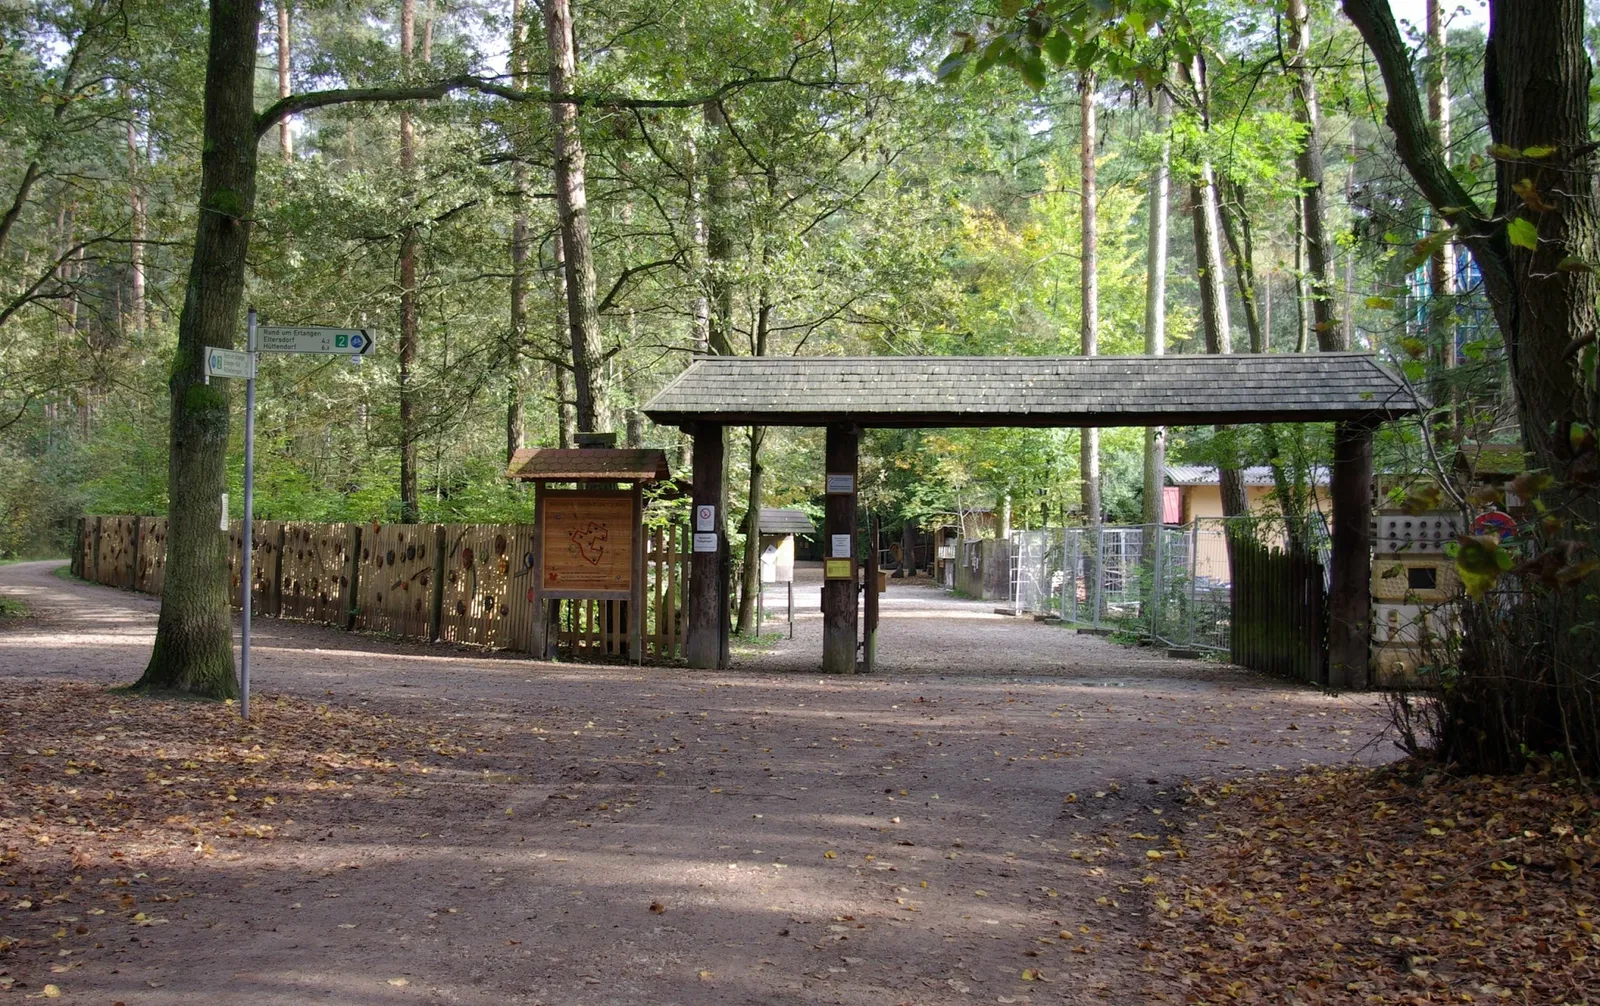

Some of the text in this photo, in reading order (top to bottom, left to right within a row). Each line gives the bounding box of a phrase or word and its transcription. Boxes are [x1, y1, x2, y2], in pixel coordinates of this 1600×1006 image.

[263, 328, 280, 336] Rund
[293, 329, 322, 338] Erlangen
[338, 335, 345, 347] 2
